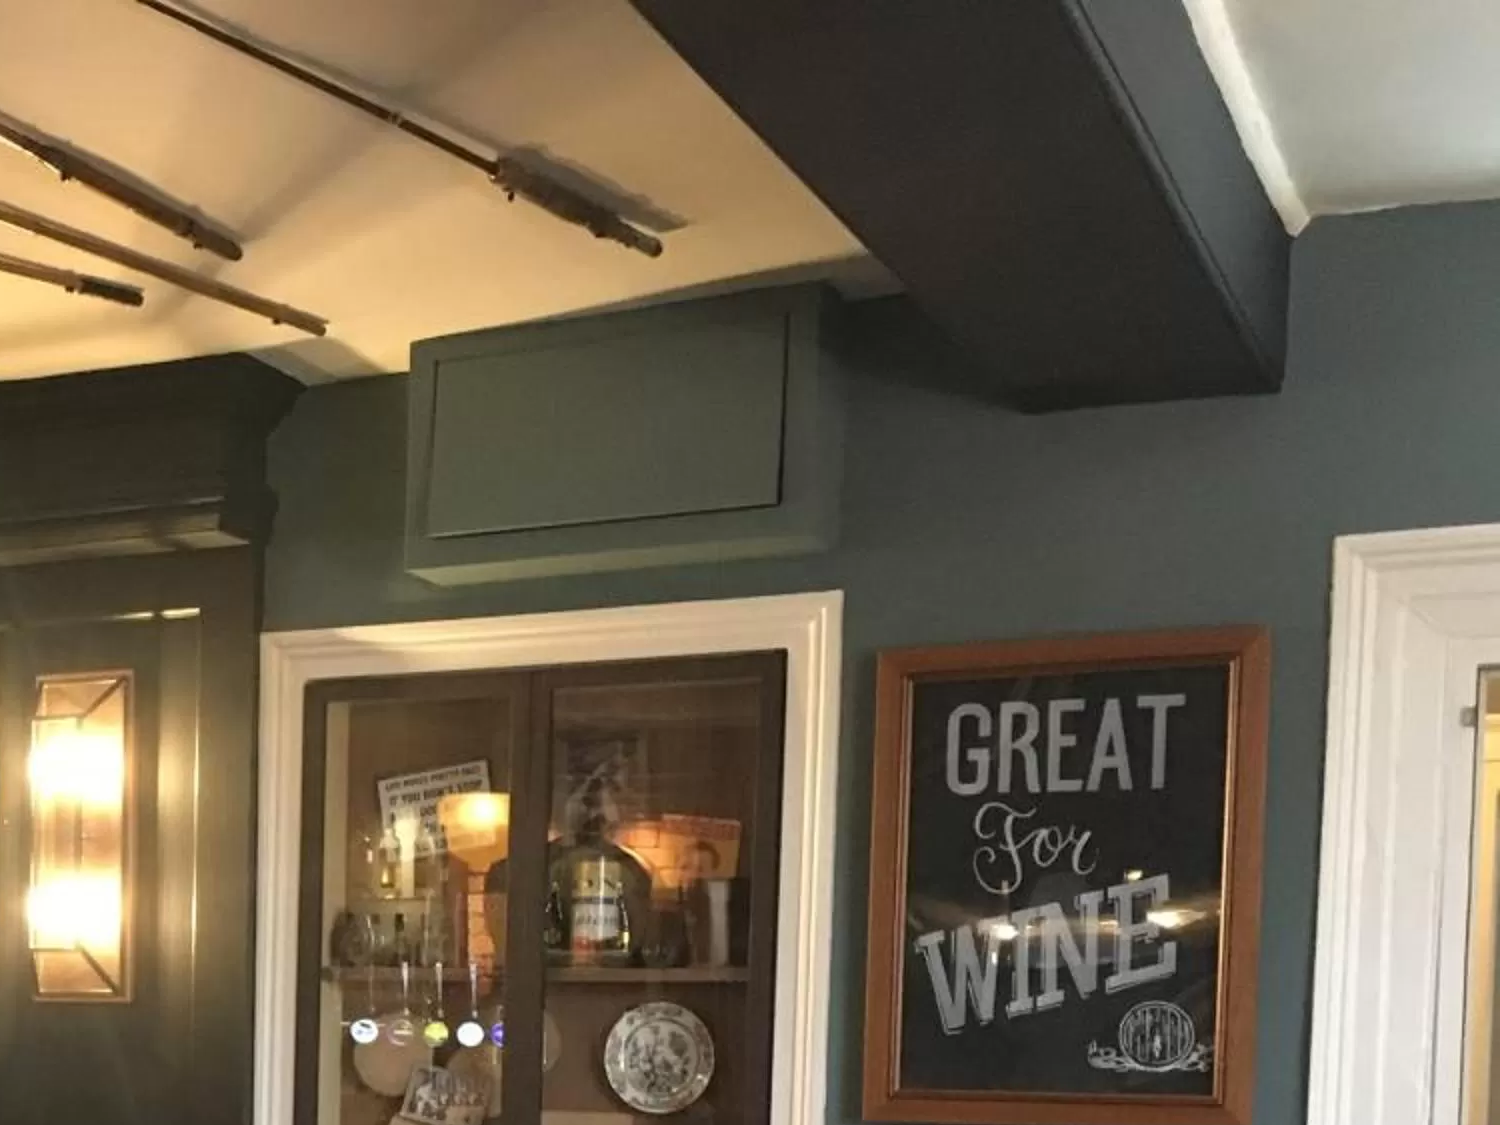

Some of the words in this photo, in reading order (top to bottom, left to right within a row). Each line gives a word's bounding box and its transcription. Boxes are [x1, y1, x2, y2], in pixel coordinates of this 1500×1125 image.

[946, 693, 1186, 796] GREAT
[973, 802, 1100, 894] For
[915, 874, 1177, 1035] WINE
